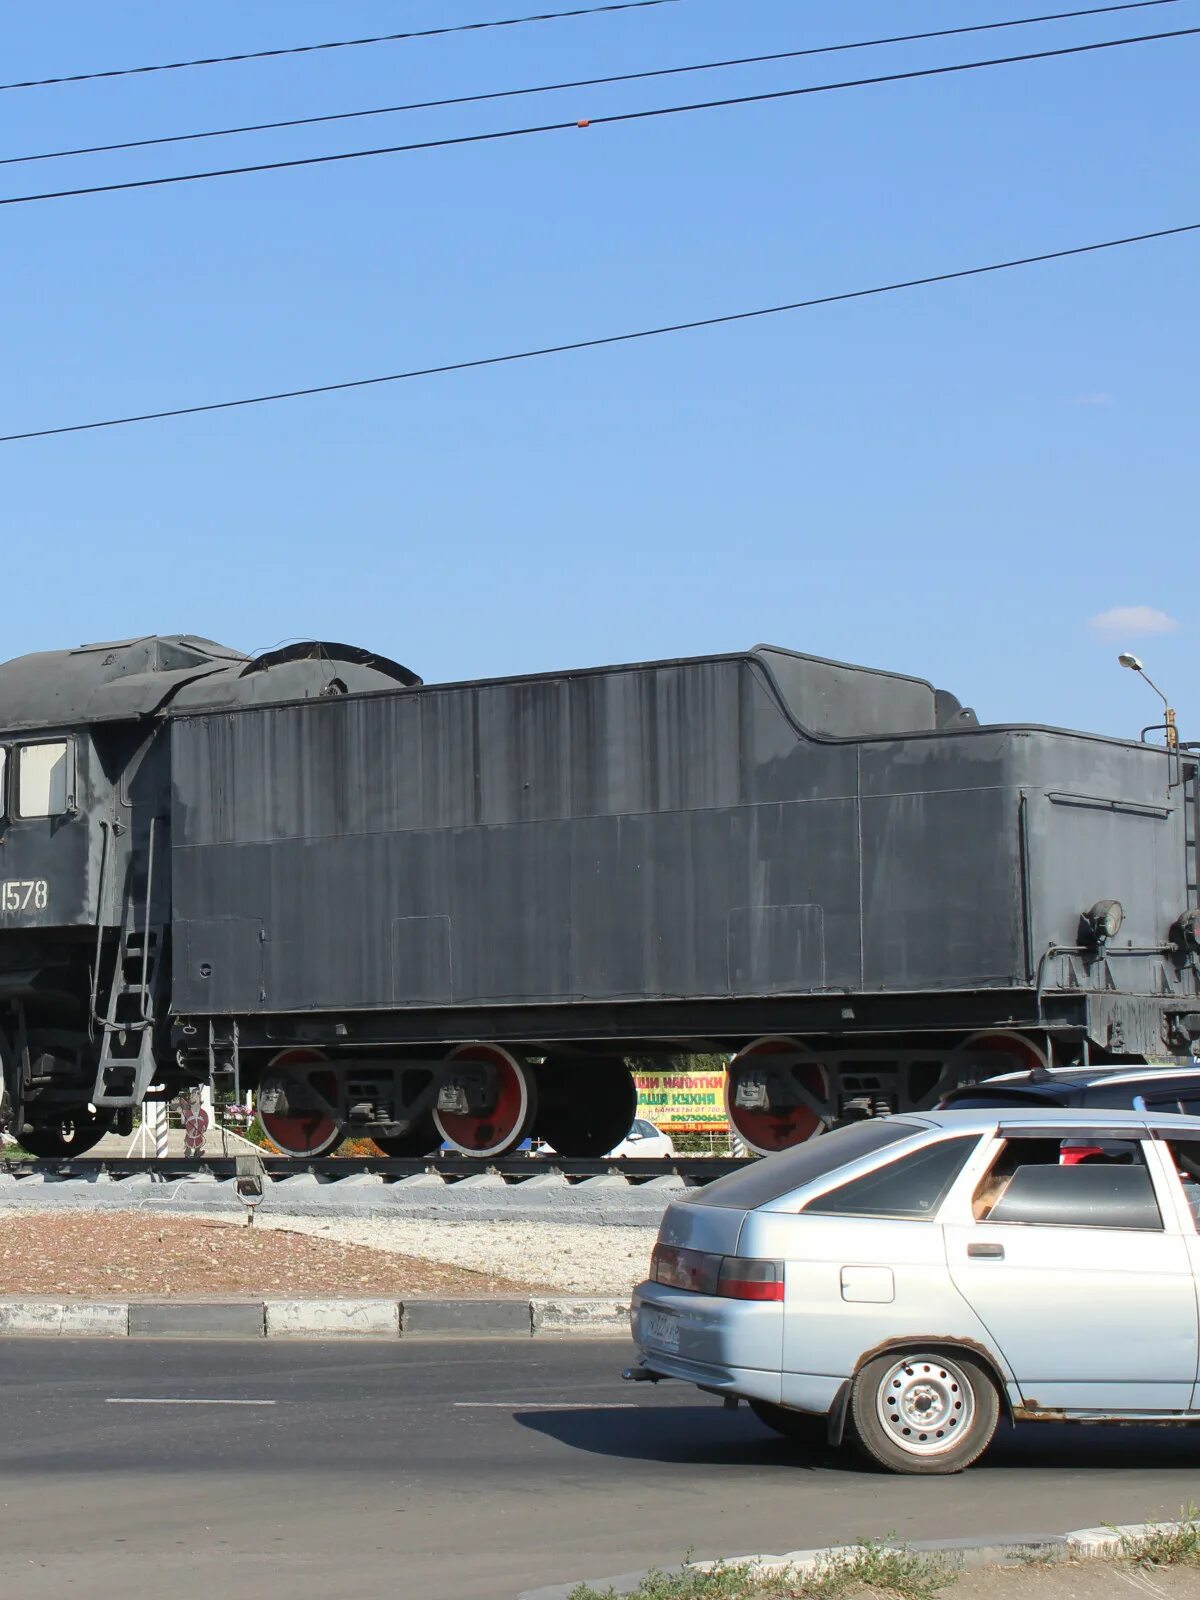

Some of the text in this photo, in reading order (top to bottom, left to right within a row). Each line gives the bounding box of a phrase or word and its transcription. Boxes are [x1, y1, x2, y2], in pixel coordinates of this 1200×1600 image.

[635, 1077, 722, 1089] ШИ НАПИТКИ
[672, 1093, 715, 1105] КУХНЯ
